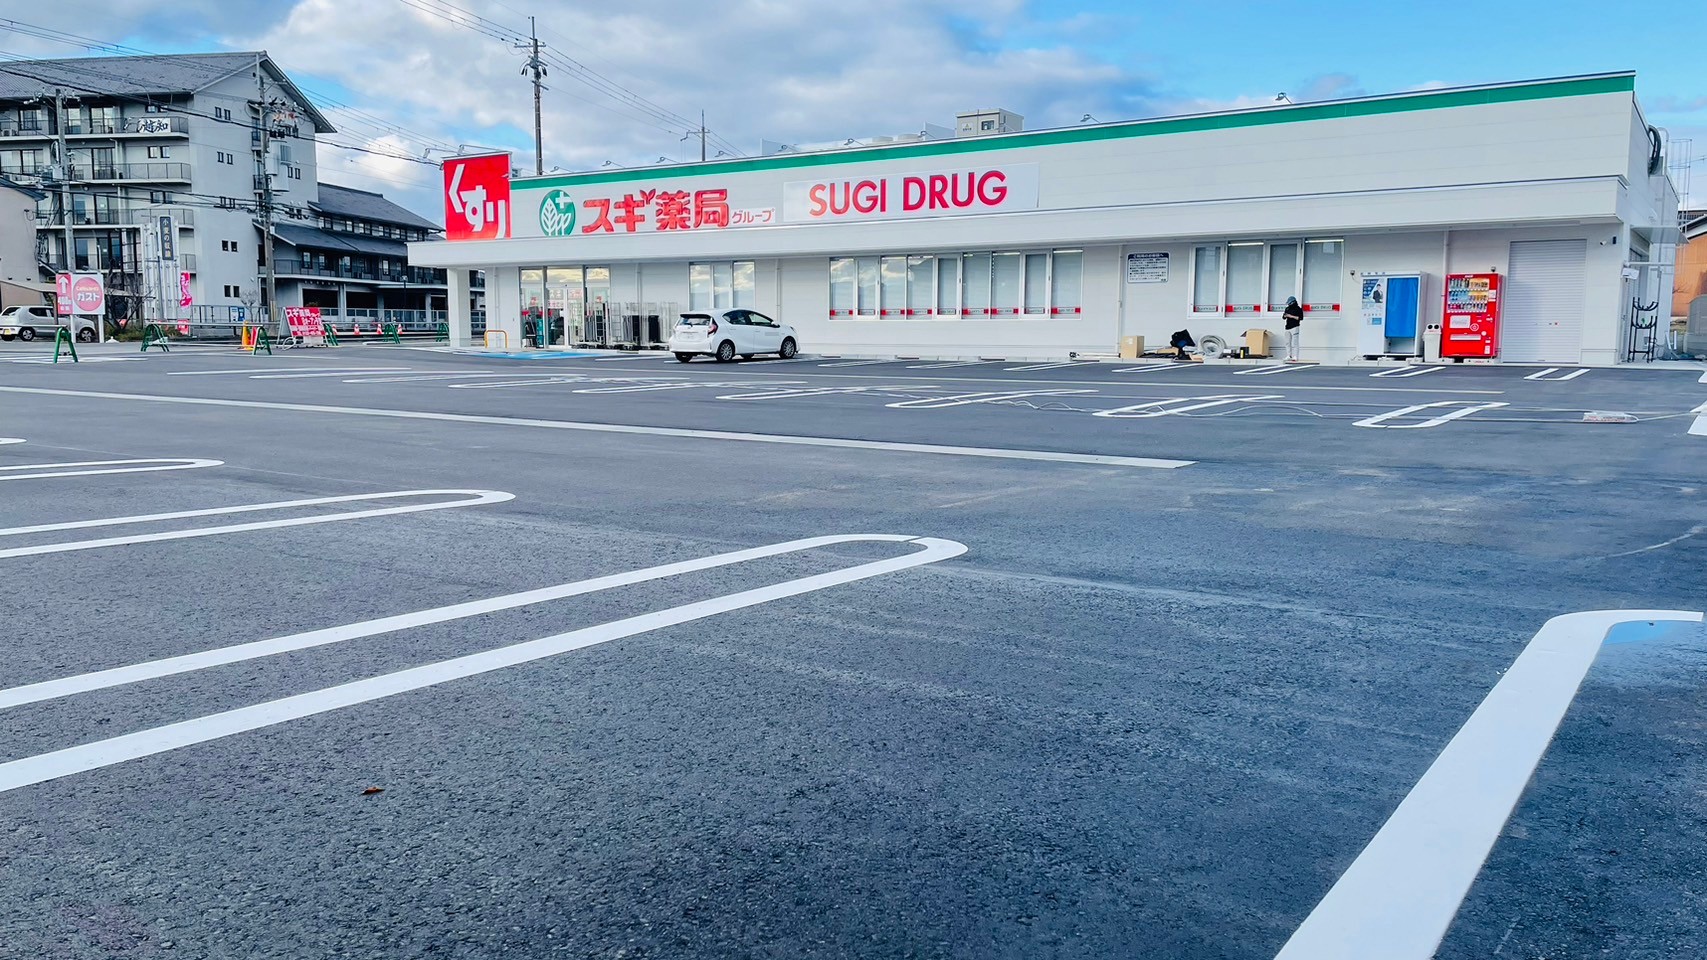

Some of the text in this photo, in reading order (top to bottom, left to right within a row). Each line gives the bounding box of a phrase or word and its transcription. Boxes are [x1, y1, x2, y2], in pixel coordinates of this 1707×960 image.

[448, 163, 506, 239] くすり
[582, 188, 775, 233] スギ薬局 グループ
[809, 170, 1007, 216] SUGI DRUG
[77, 292, 100, 301] ガスト
